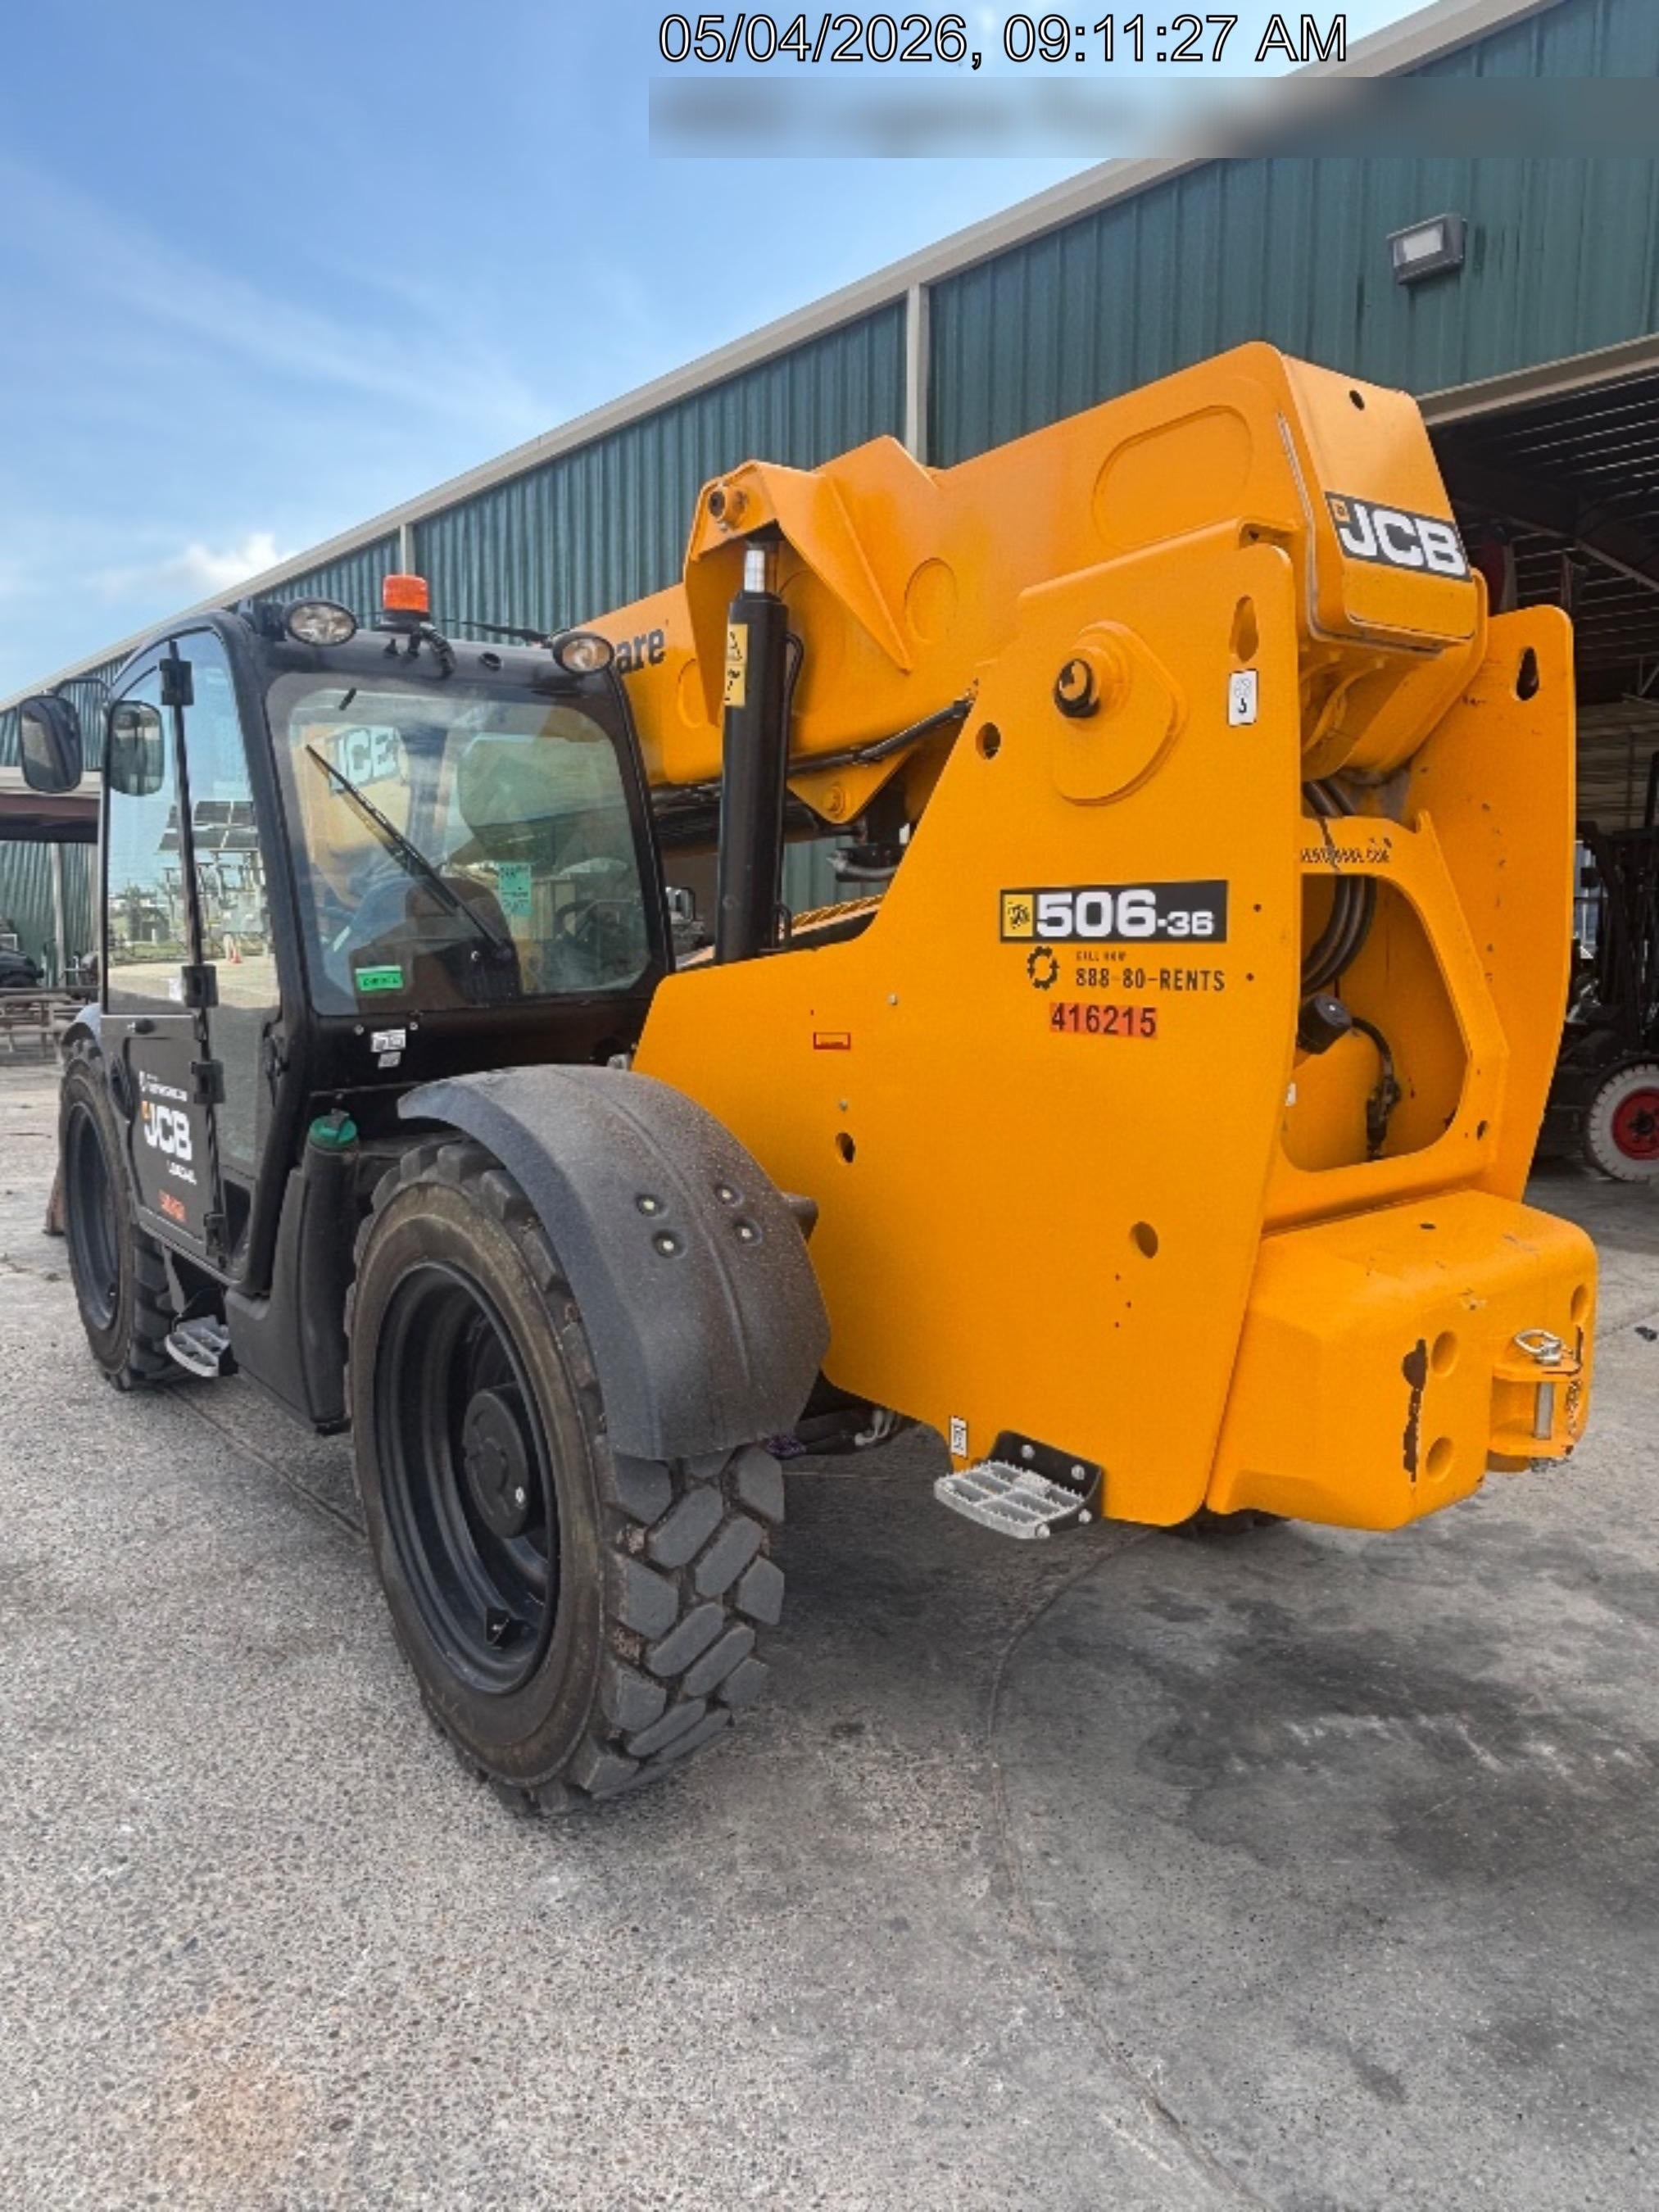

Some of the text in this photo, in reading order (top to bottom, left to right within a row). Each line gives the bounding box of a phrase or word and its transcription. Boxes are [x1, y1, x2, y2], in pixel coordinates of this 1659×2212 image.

[1339, 502, 1467, 576] JCB
[614, 628, 668, 674] are
[1036, 888, 1215, 938] 506-36
[1050, 1002, 1158, 1039] 416215
[143, 1103, 193, 1162] JCB
